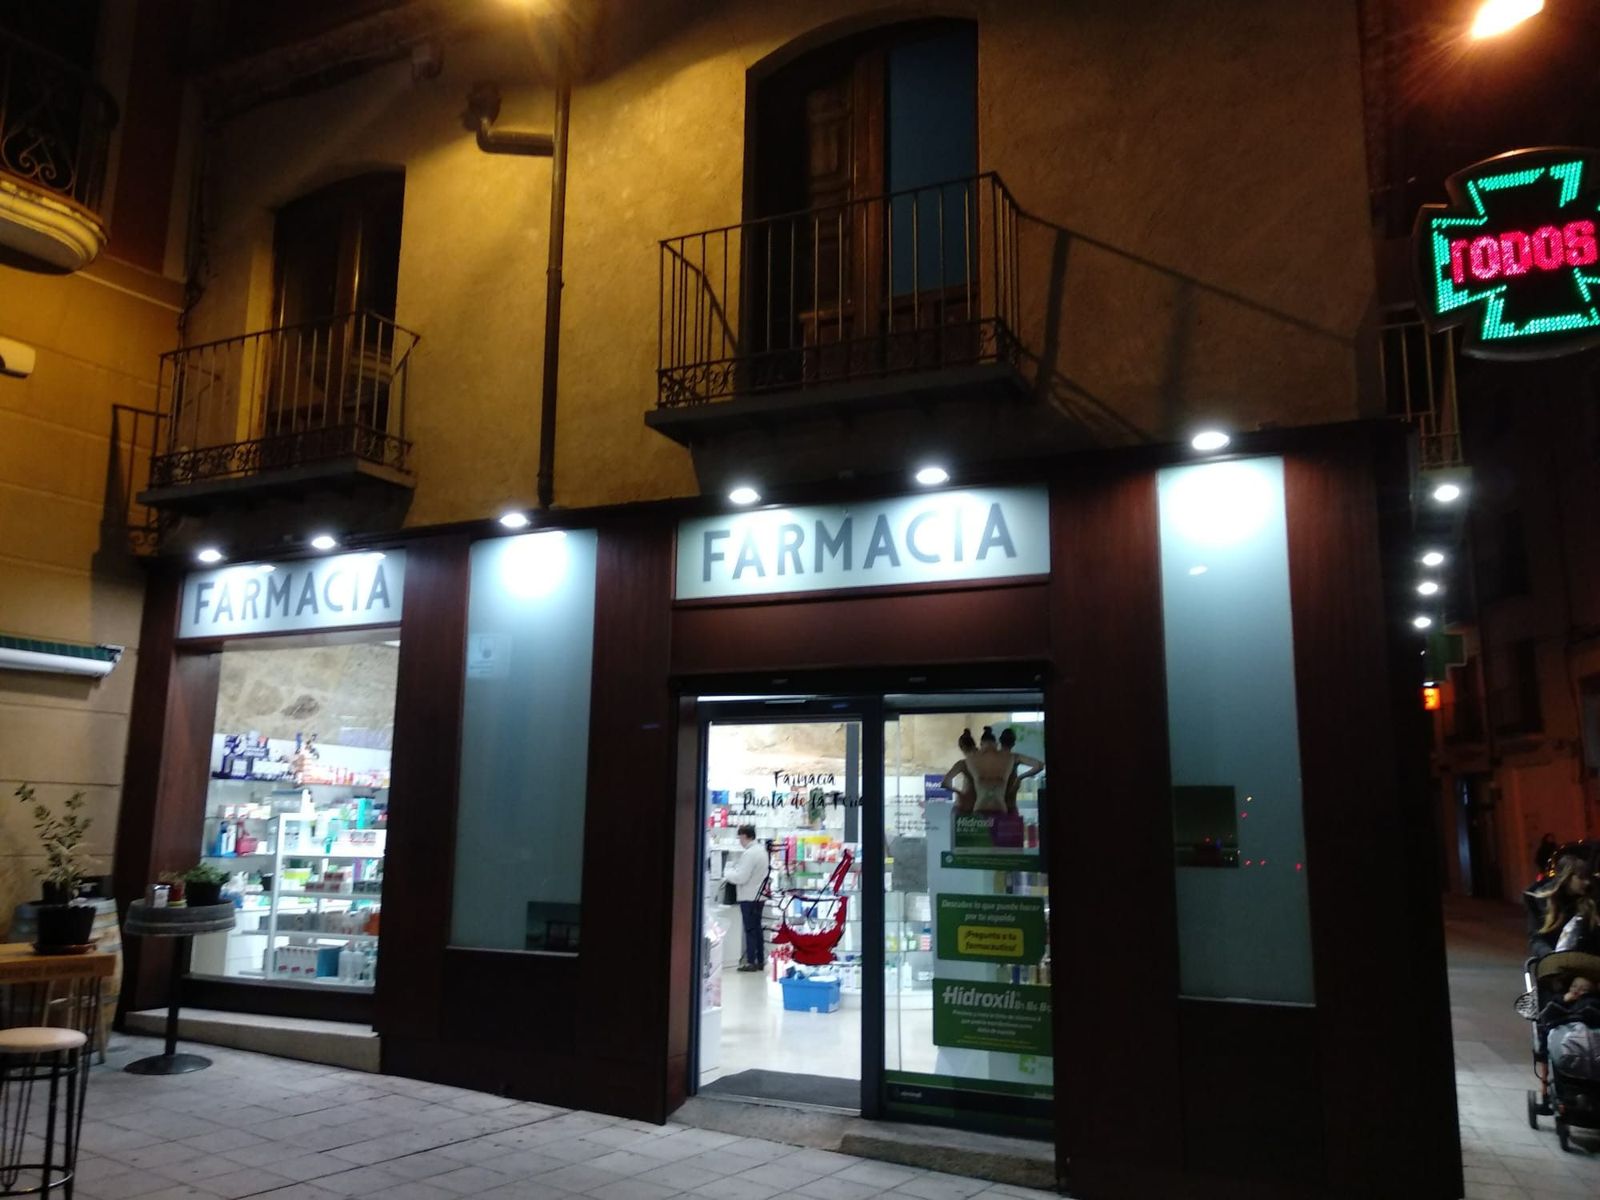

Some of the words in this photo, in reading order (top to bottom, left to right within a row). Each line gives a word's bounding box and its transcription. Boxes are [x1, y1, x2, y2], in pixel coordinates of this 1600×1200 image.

[702, 503, 1017, 582] FARMACIA
[193, 564, 391, 625] FARMACIA
[773, 769, 836, 788] Farmacia
[790, 791, 806, 809] de
[942, 985, 1016, 1009] Hidroxil
